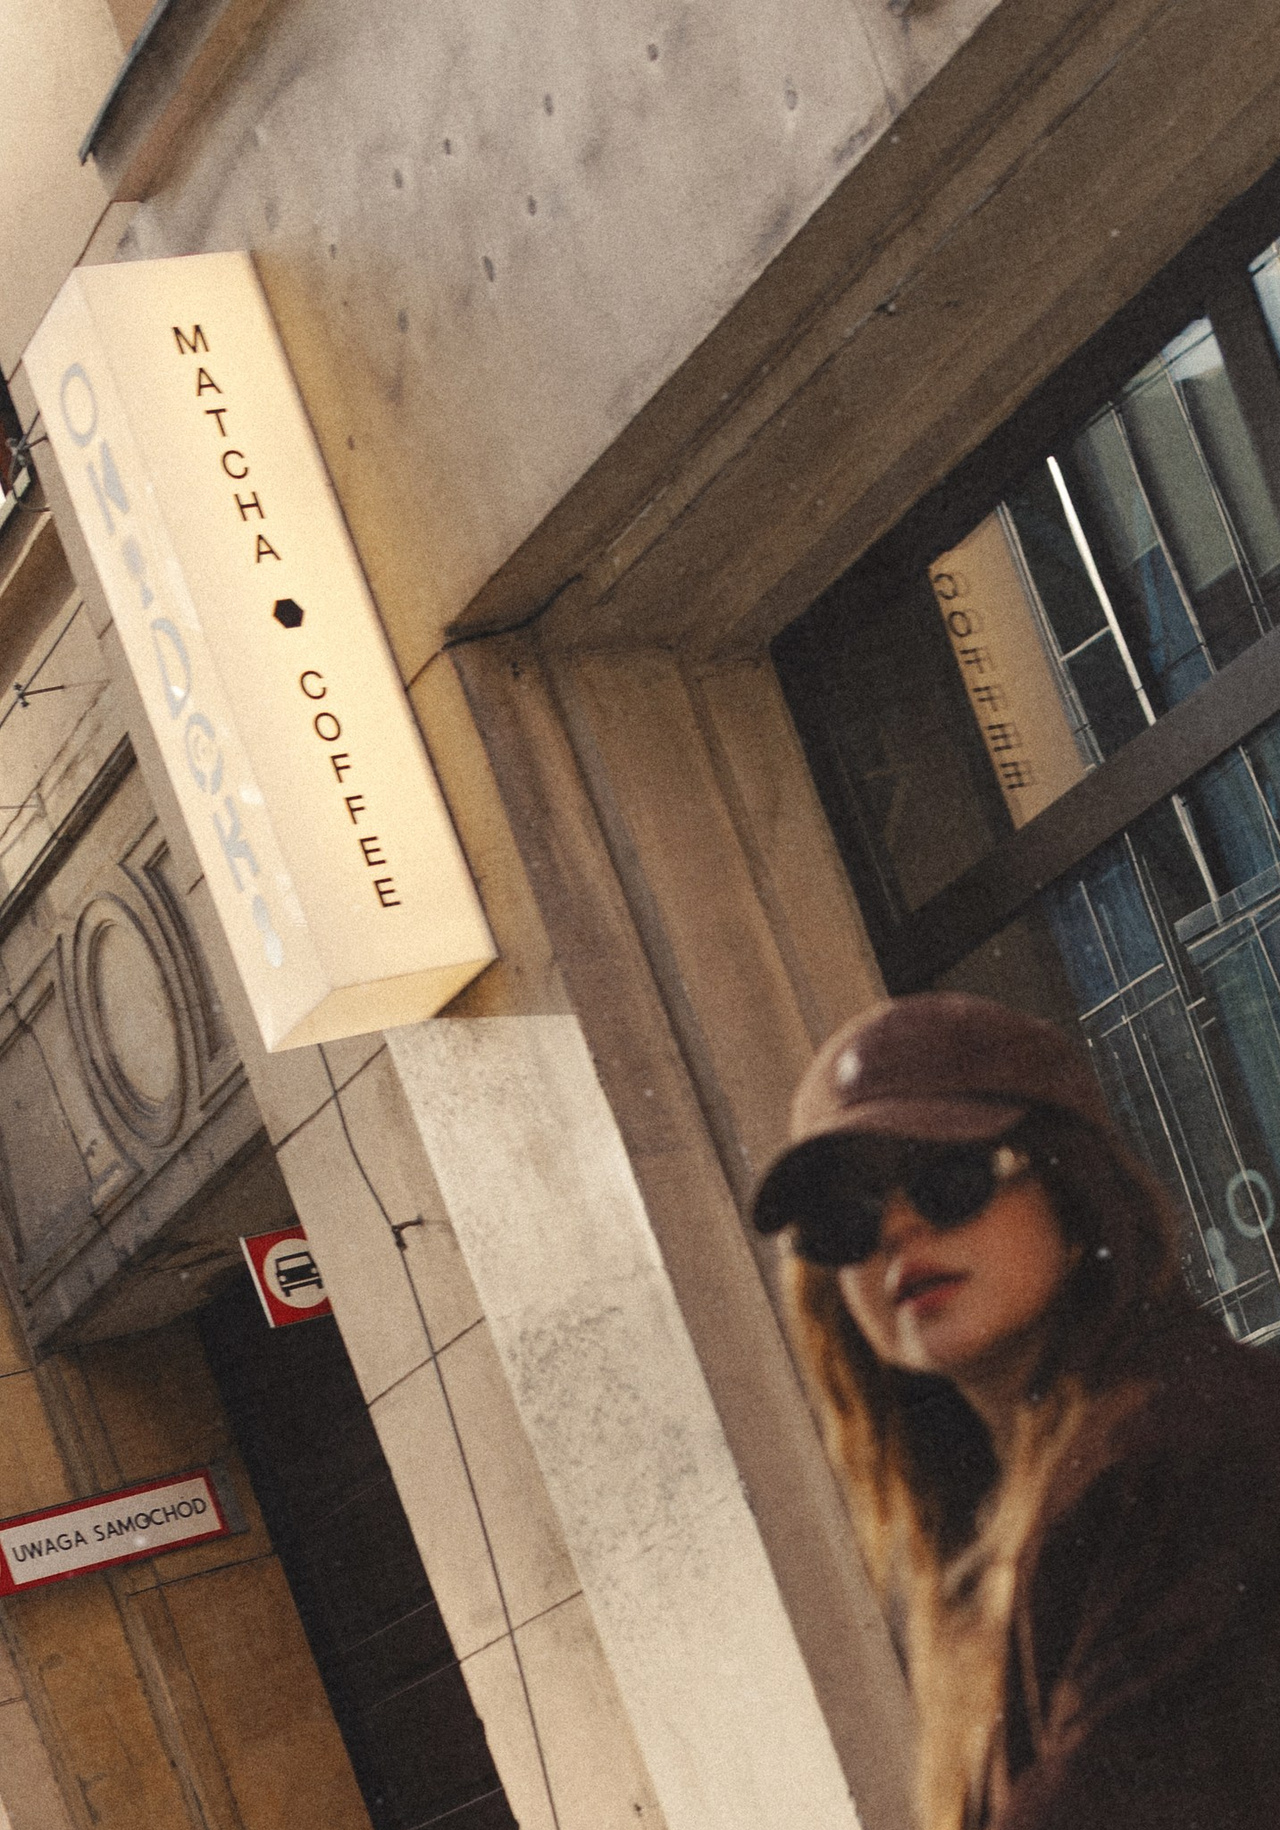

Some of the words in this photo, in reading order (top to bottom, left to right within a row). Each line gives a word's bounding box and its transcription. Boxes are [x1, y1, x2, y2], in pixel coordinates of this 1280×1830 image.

[172, 324, 282, 564] MATCHA
[300, 671, 402, 907] COFFEE
[12, 1530, 88, 1563] UWAGA
